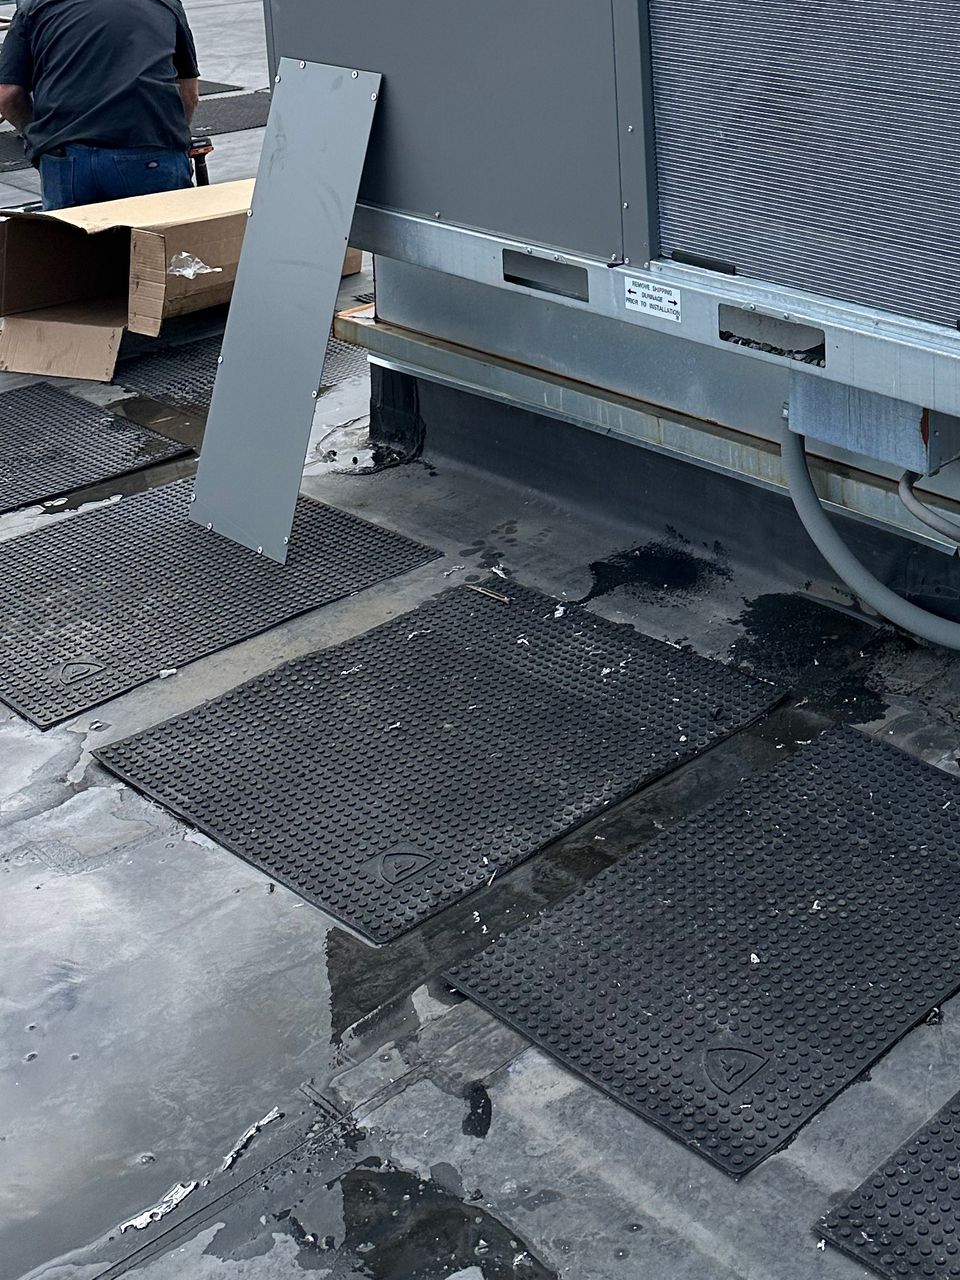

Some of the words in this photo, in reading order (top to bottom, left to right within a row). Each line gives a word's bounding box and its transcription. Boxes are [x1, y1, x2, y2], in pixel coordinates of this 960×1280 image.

[632, 280, 650, 291] REMOVE
[652, 285, 672, 296] SHIPPING
[625, 297, 639, 305] PRIOR
[640, 300, 647, 308] TO
[649, 303, 681, 316] INSTALLATION
